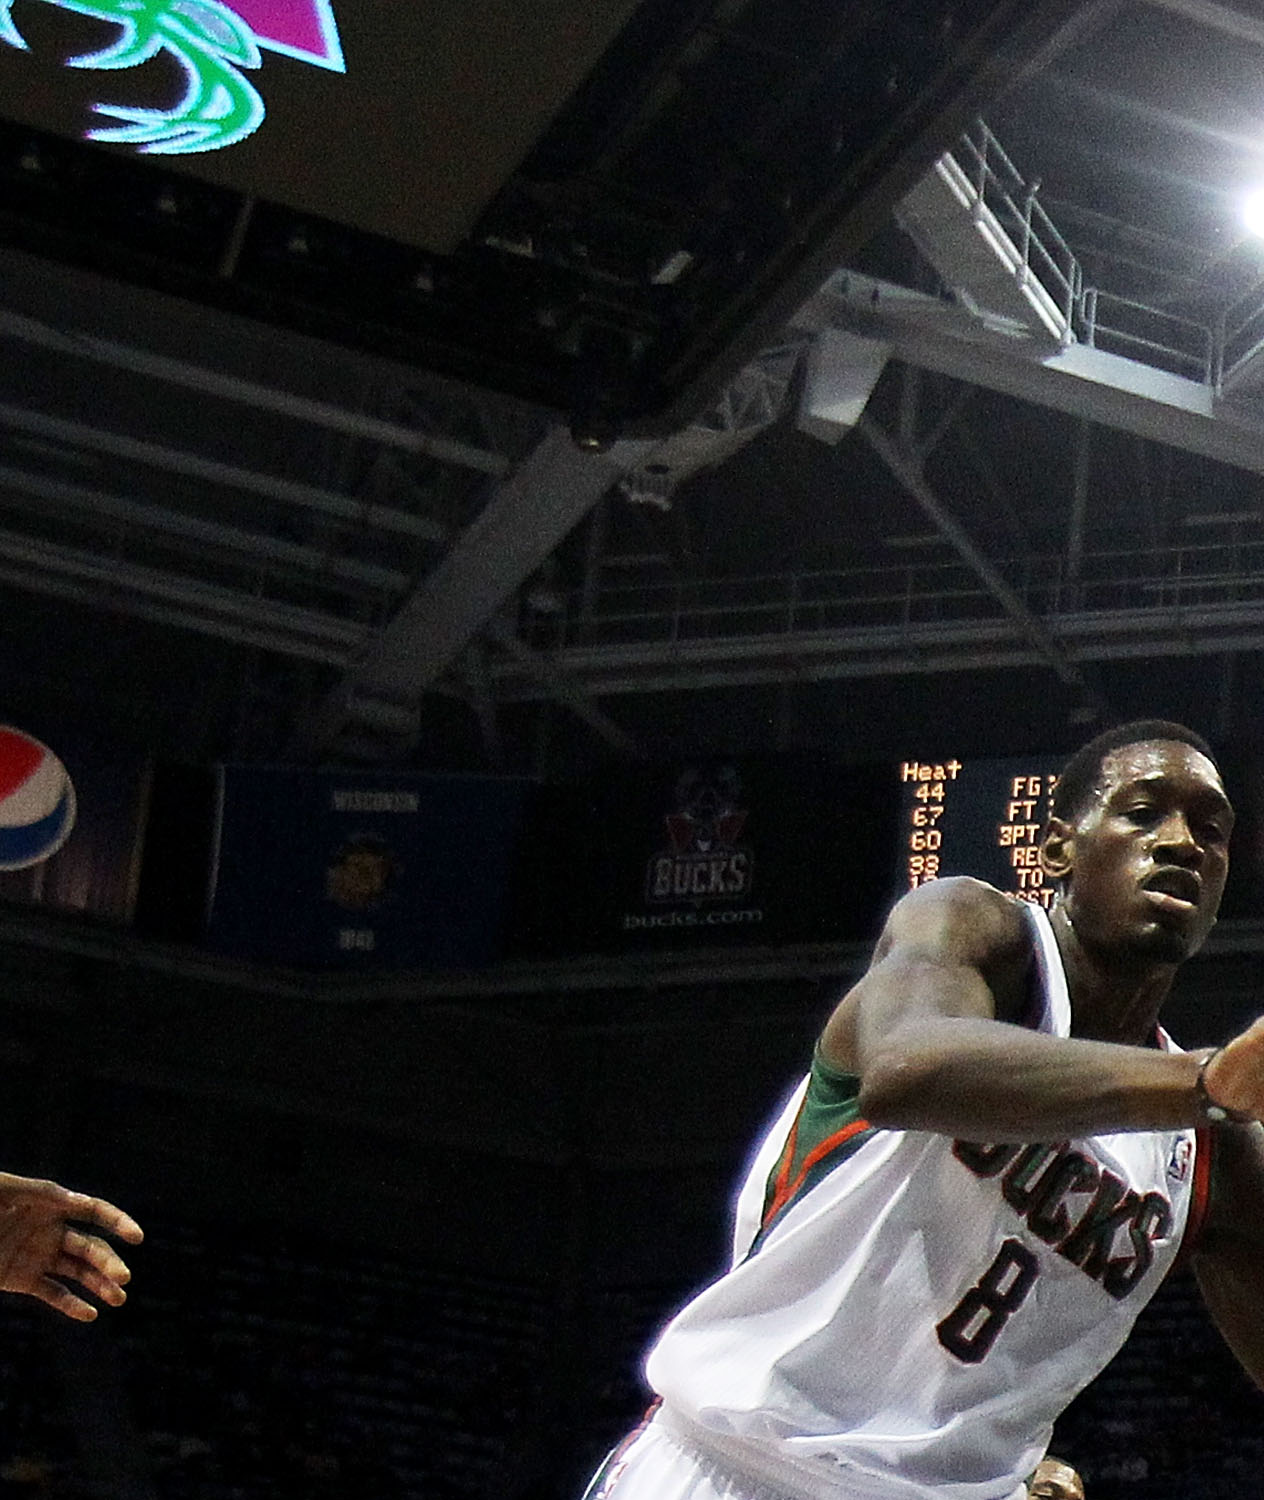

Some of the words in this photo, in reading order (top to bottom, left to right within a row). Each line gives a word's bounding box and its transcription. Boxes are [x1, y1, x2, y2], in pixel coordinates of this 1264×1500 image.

[902, 759, 962, 782] Heat
[915, 783, 945, 803] 44
[1012, 776, 1042, 797] FG
[913, 806, 944, 826] 67
[1008, 800, 1037, 821] FT
[911, 830, 942, 851] 60
[1000, 824, 1040, 846] 3PT
[1012, 847, 1042, 867] RE
[653, 853, 748, 896] BUCKS
[1016, 868, 1044, 888] TO
[623, 912, 764, 930] bucks.com
[936, 1237, 1040, 1364] 8
